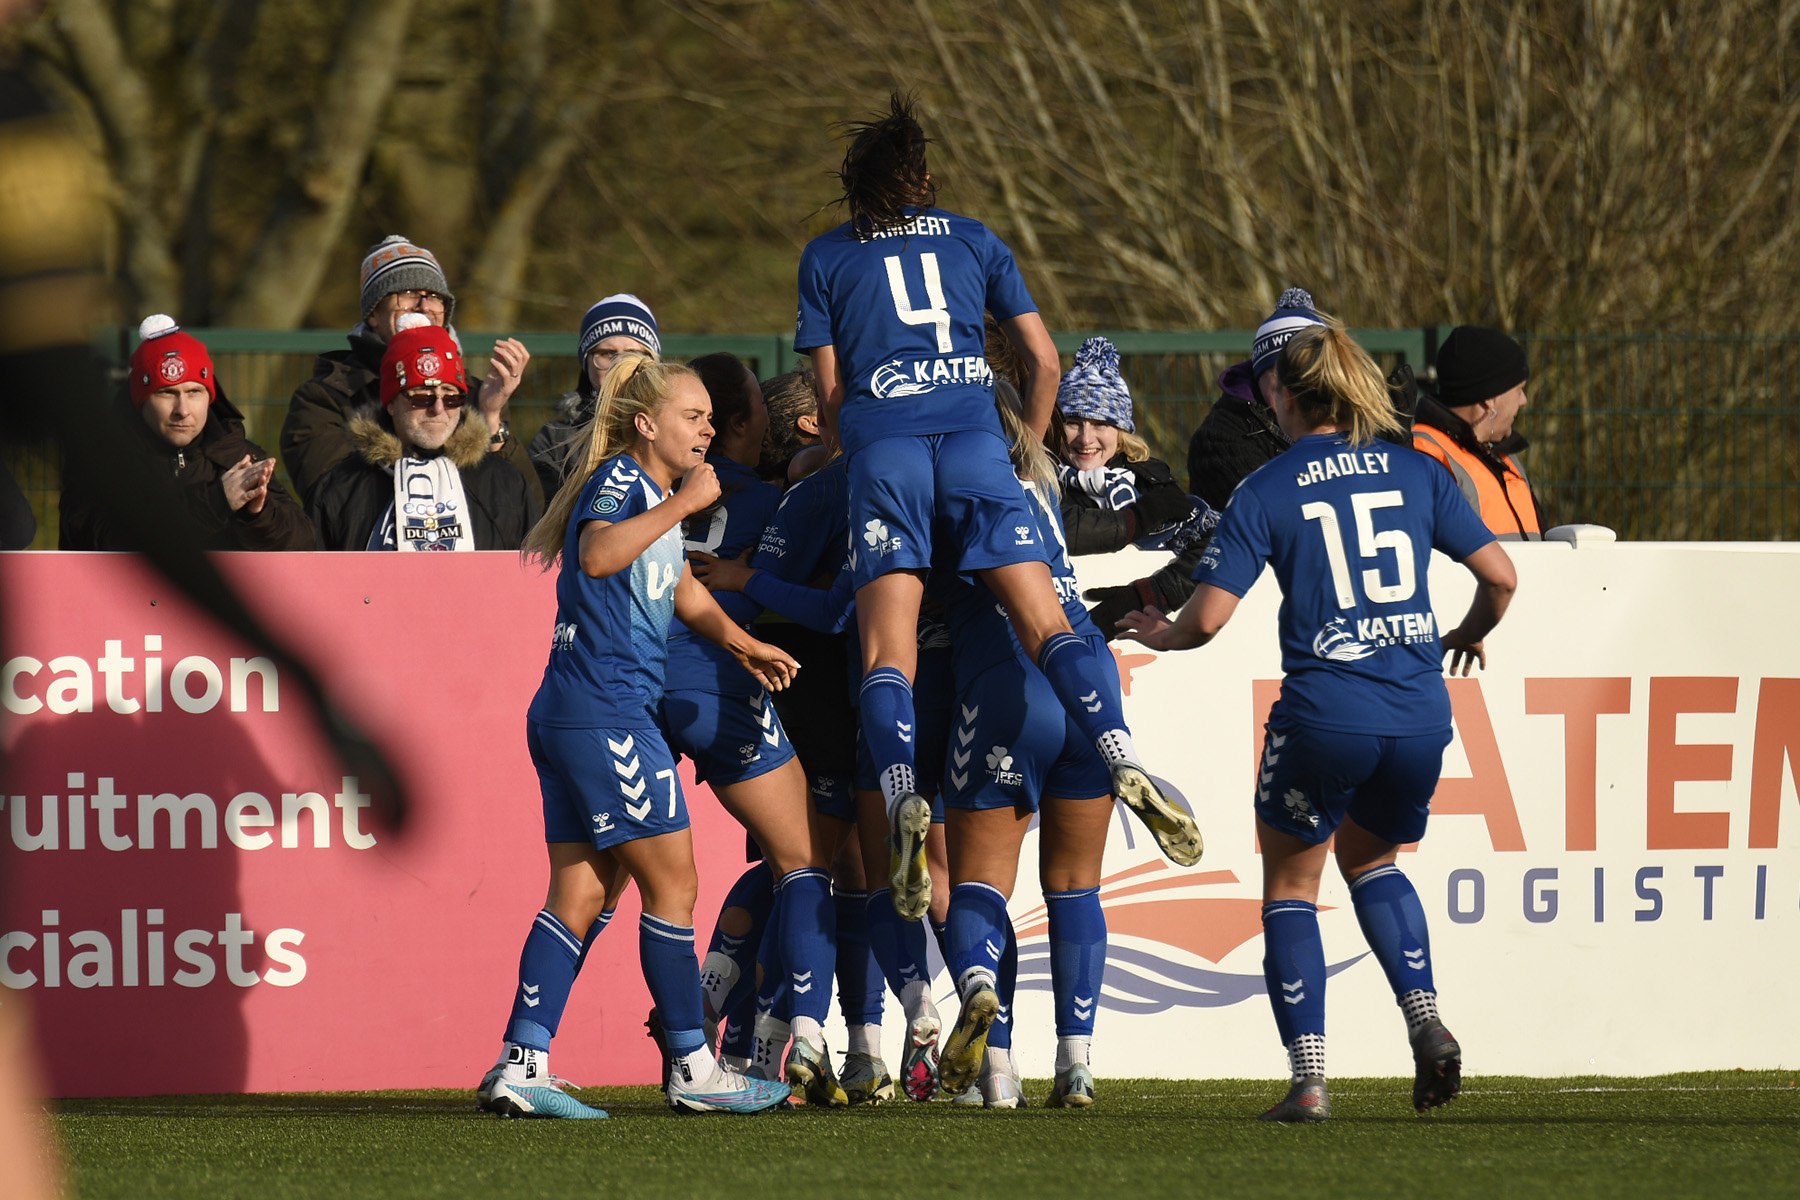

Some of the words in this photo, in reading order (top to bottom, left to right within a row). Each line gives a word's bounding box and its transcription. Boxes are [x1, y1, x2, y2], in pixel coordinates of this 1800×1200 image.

[883, 253, 953, 353] 4
[581, 321, 622, 352] DURHAM
[914, 357, 993, 382] KATEM
[758, 543, 786, 559] pany
[1301, 490, 1416, 609] 15
[1357, 612, 1433, 642] KATEM
[1, 634, 280, 714] cation
[655, 768, 677, 818] 7
[1000, 771, 1022, 782] PFC
[1000, 778, 1022, 787] TRUST
[0, 772, 377, 851] uitment
[1447, 865, 1800, 924] OGISTI
[0, 909, 307, 990] cialists
